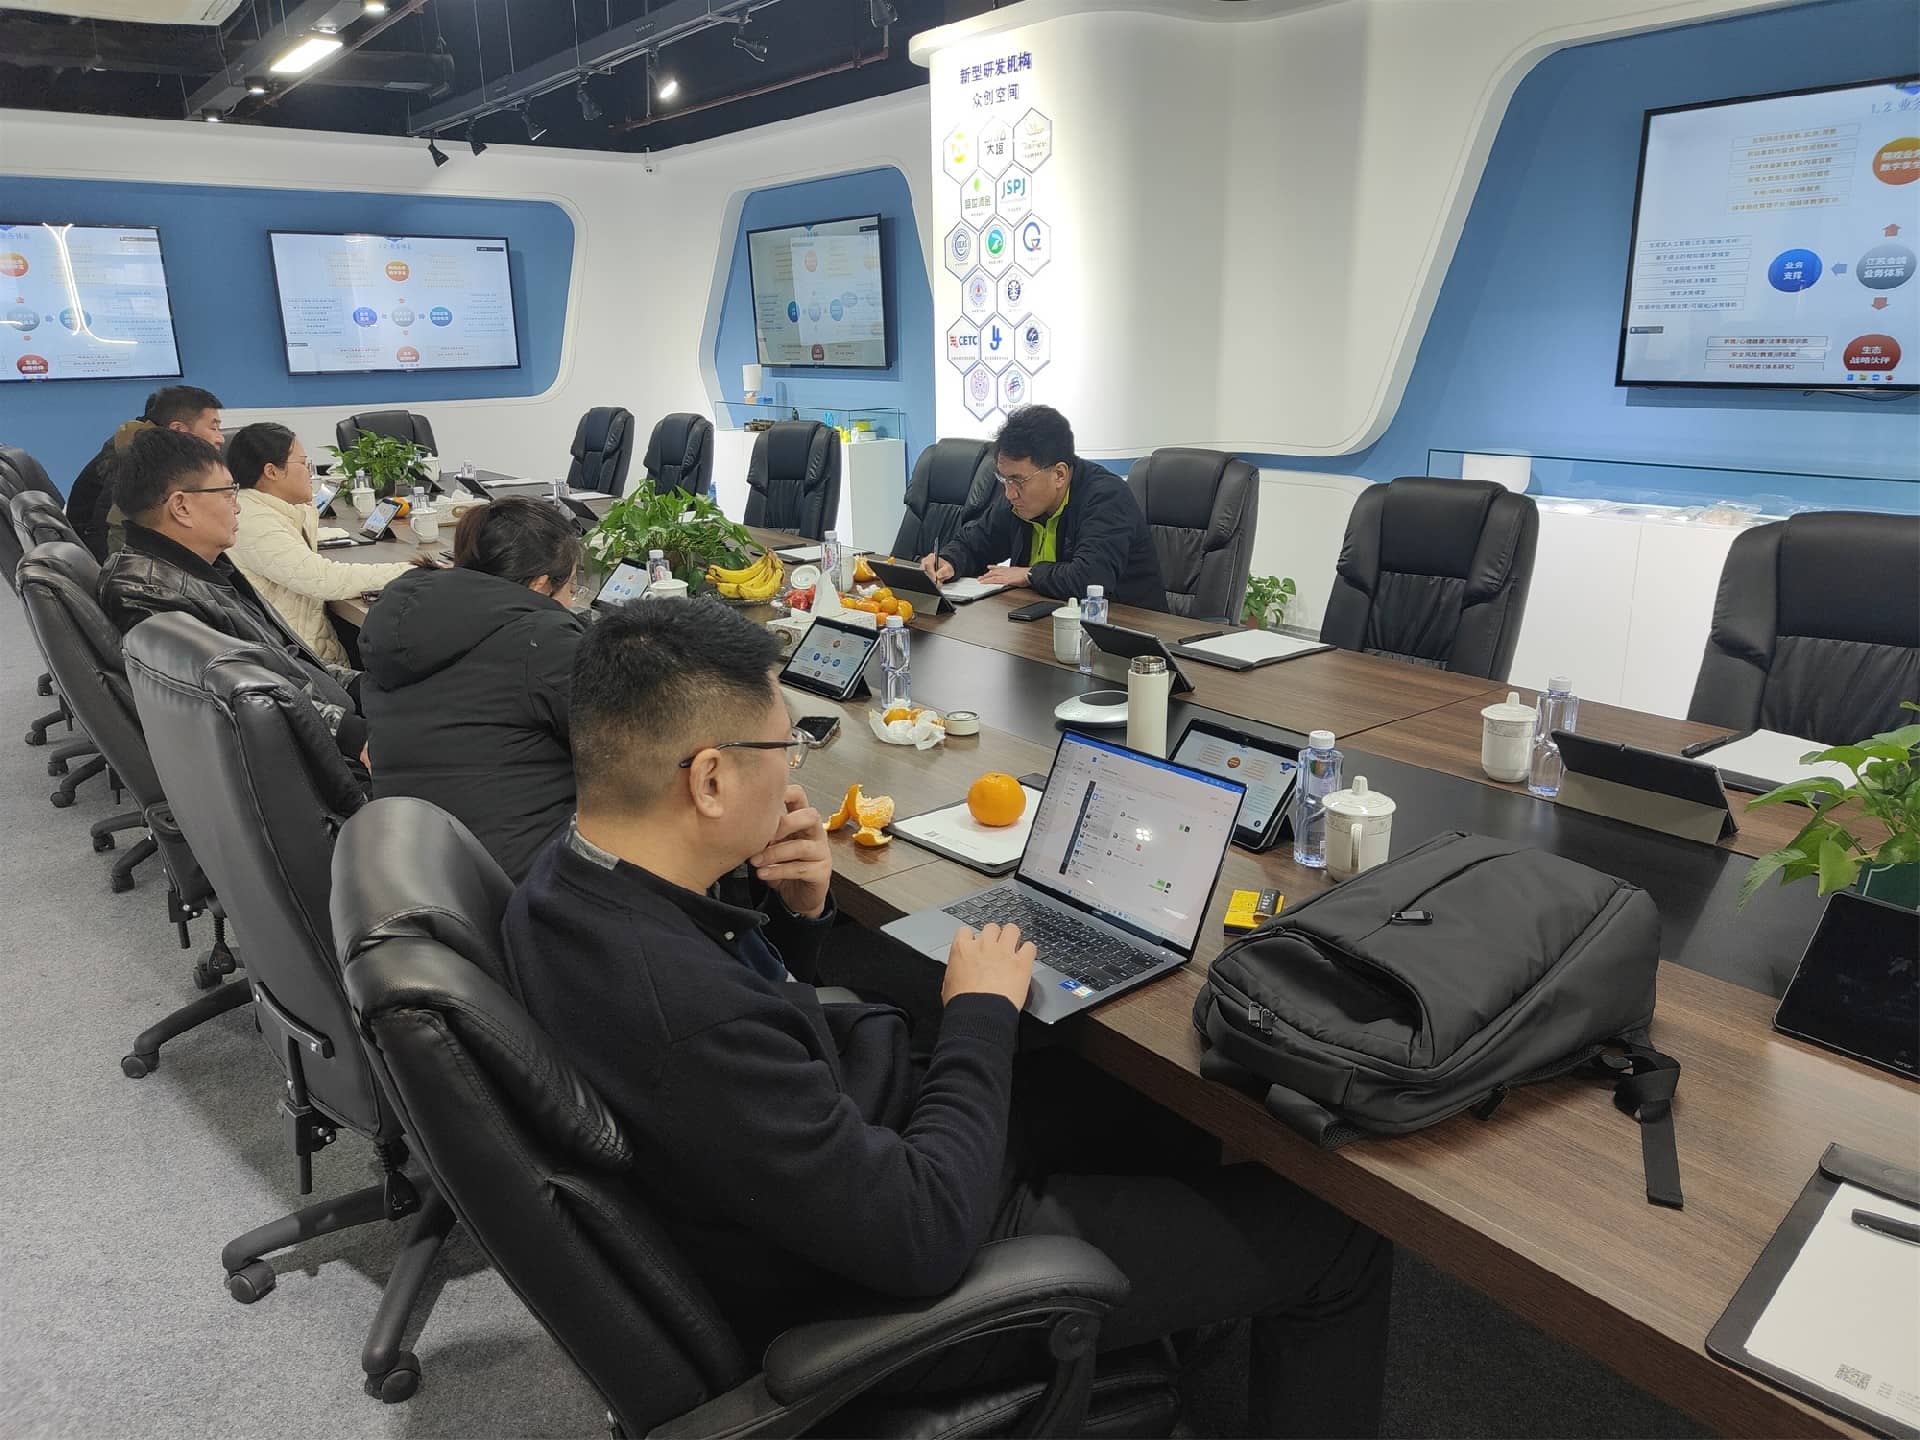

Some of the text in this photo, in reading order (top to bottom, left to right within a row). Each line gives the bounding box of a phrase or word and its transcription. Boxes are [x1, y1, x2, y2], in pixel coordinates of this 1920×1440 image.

[959, 50, 1033, 85] 新型研发机构
[972, 83, 1020, 109] 众创空间
[1001, 177, 1026, 200] JSPJ
[959, 335, 978, 346] CETC
